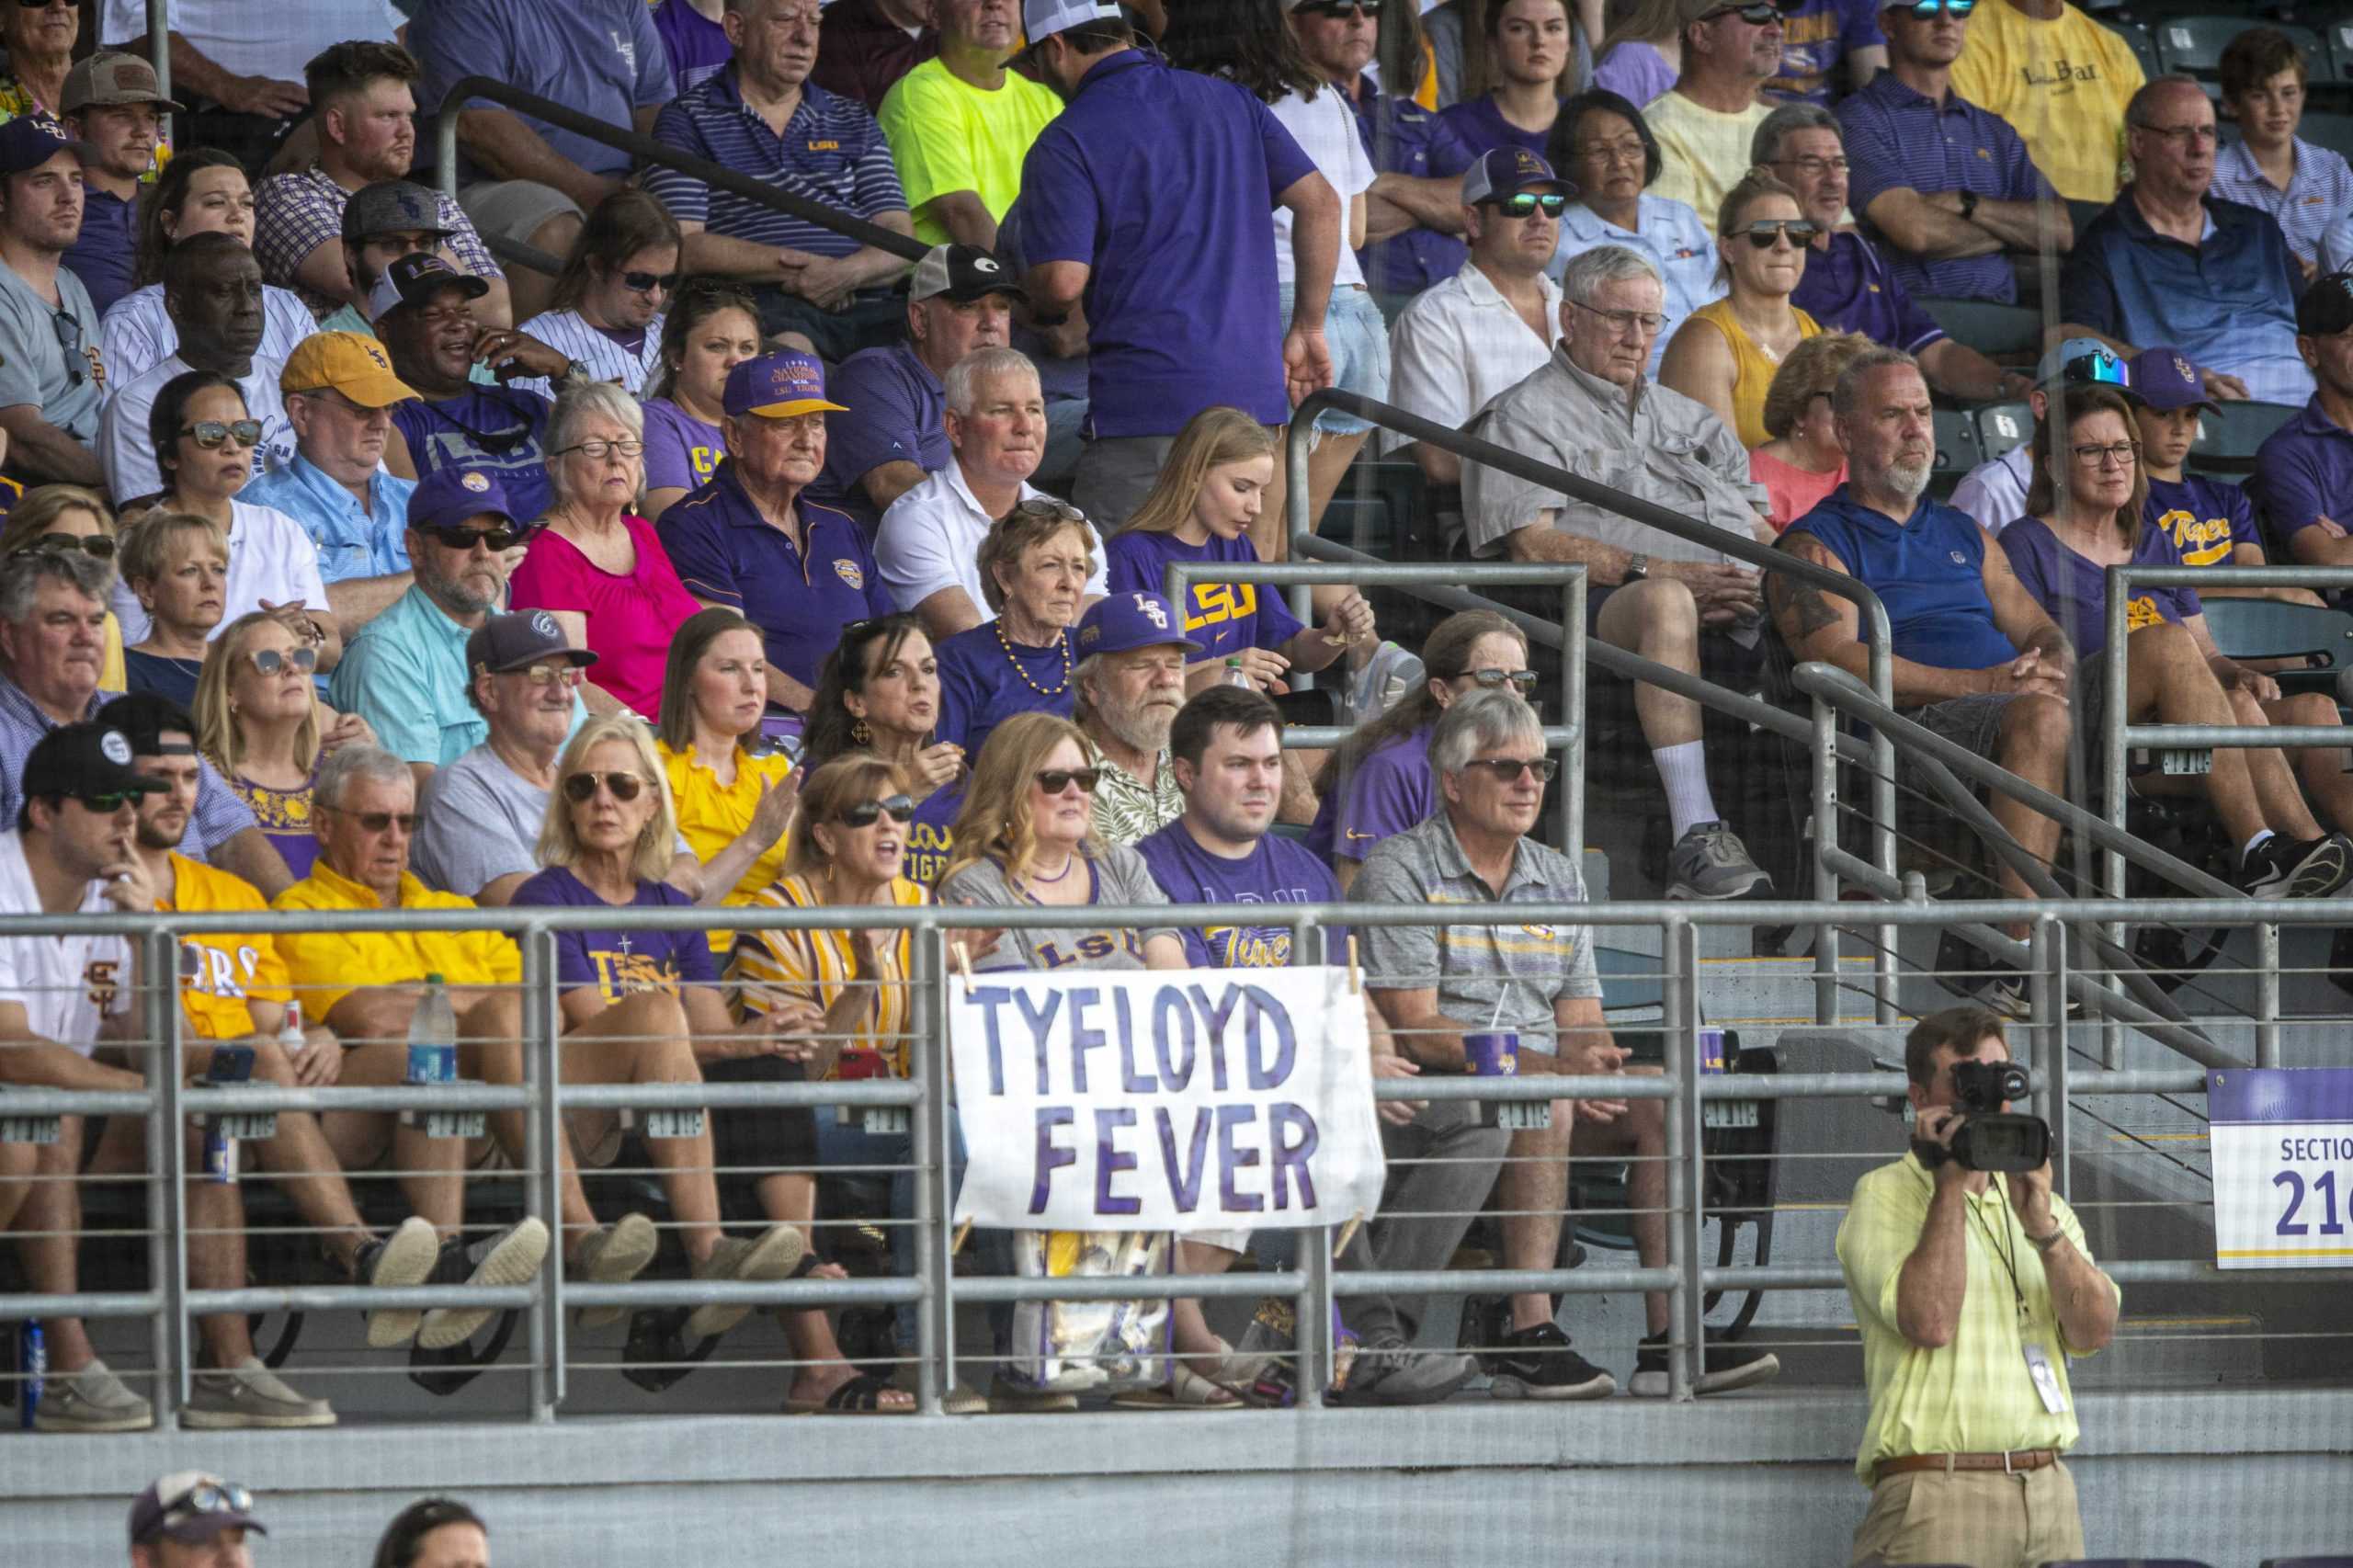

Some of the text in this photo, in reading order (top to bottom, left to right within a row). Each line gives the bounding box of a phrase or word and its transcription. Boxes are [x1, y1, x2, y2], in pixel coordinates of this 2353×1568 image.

[29, 119, 67, 140] LSU
[808, 140, 839, 152] LSU
[1132, 593, 1168, 629] LSU
[1184, 582, 1257, 632] LSU
[1205, 926, 1290, 967] Tige
[965, 982, 1297, 1096] TYFLOYD
[1028, 1102, 1319, 1215] FEVER
[2272, 1170, 2353, 1236] 21
